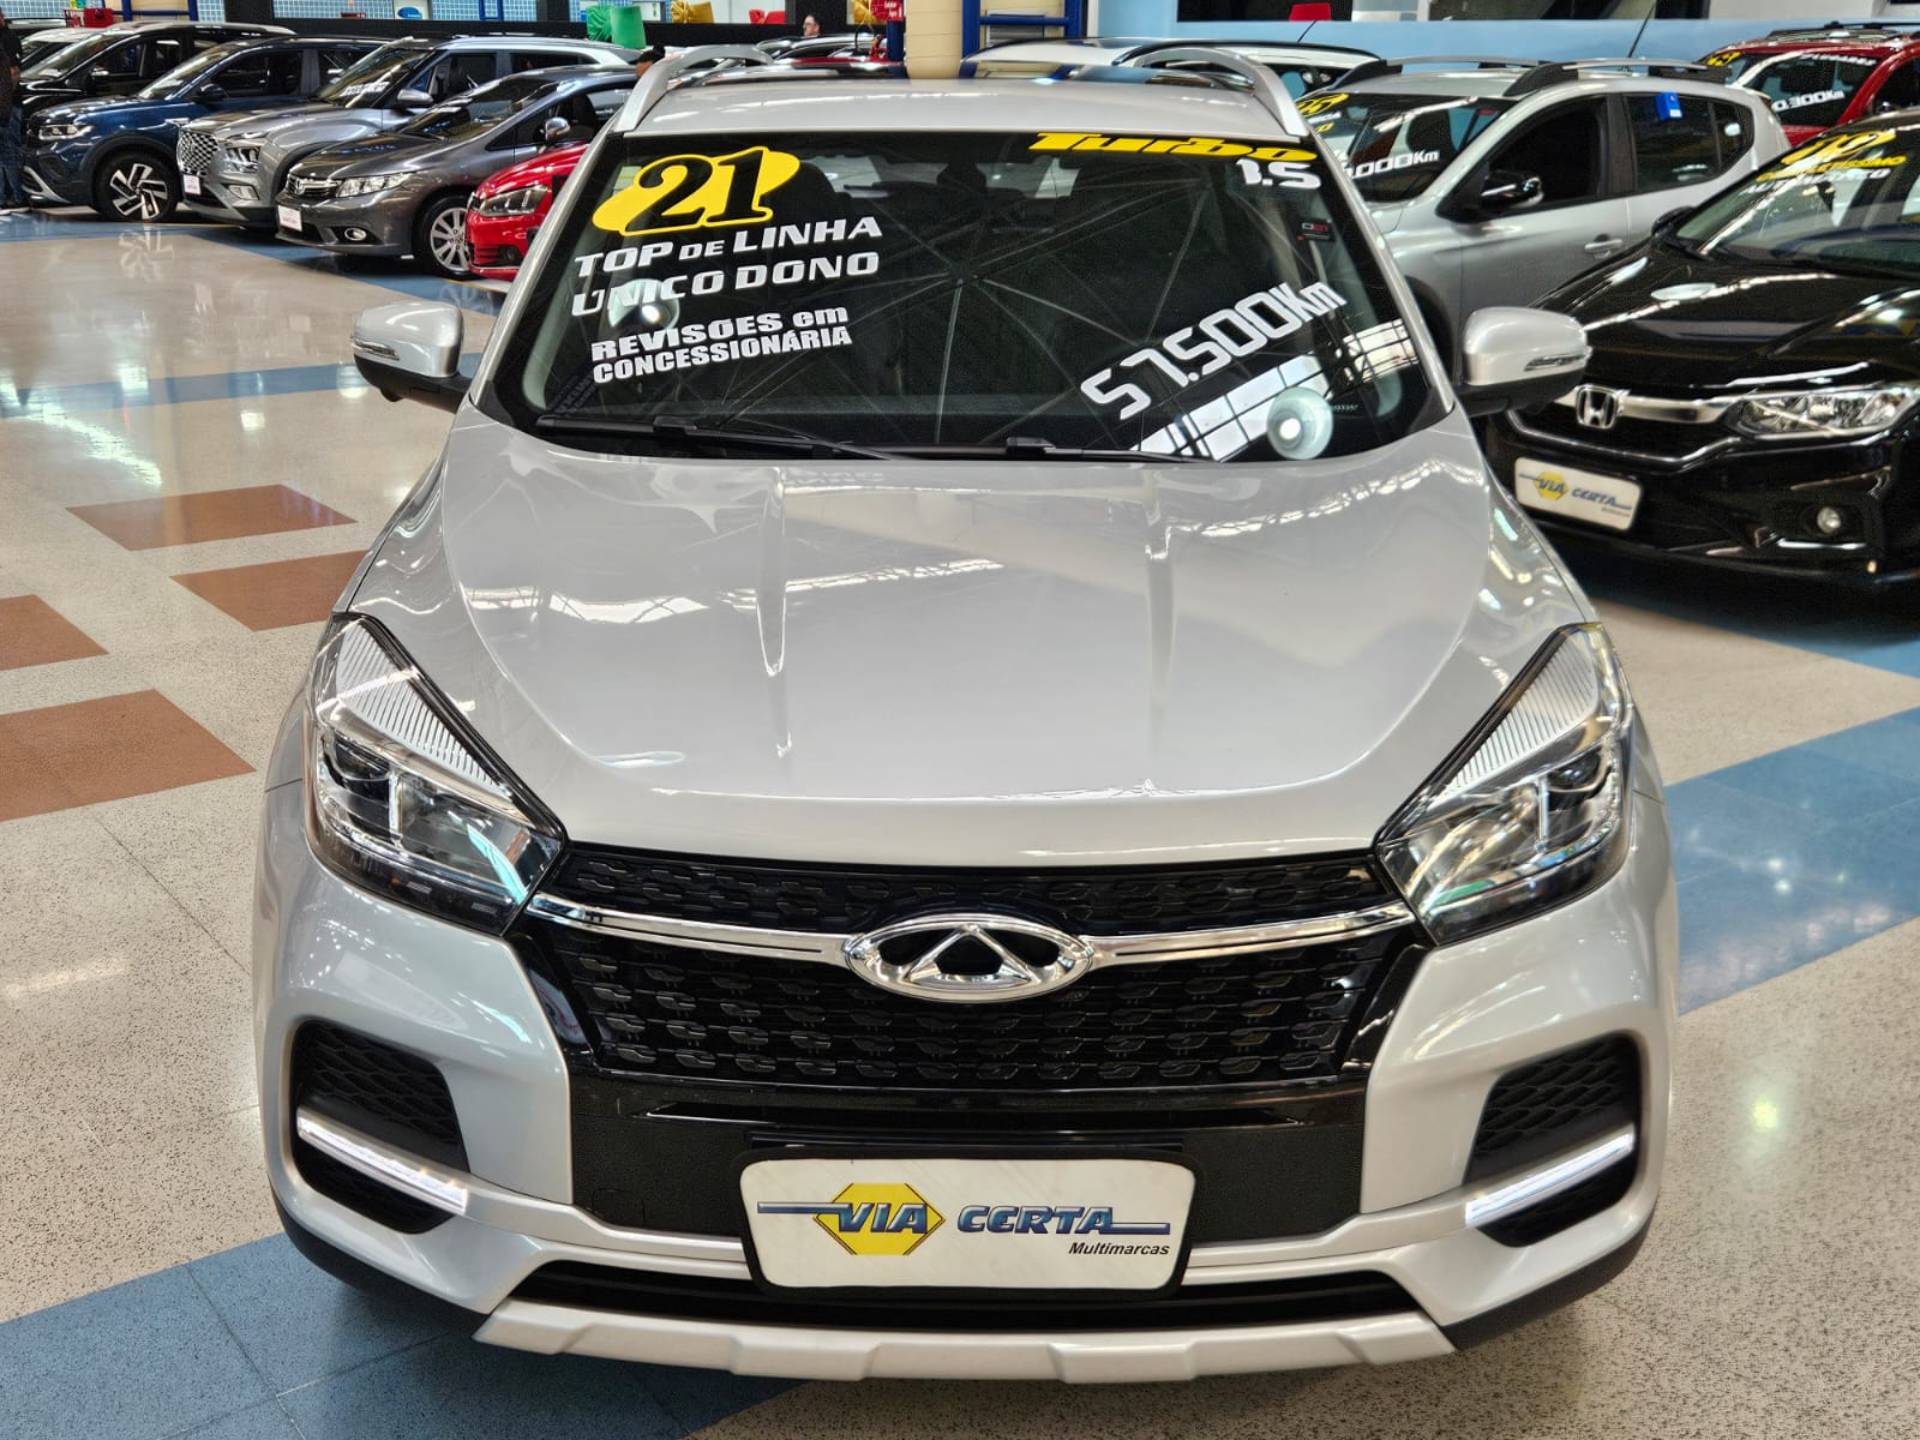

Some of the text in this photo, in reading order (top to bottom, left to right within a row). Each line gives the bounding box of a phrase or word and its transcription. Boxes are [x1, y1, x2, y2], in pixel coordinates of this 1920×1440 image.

[1028, 132, 1317, 162] Turbo
[622, 147, 770, 235] 21
[1236, 158, 1321, 190] 1.5
[574, 216, 883, 277] TOP DE LINHA
[735, 251, 880, 290] DONO
[593, 325, 853, 384] CONCESSIONÁRIA
[830, 1202, 1113, 1235] VIA CERTA
[1068, 1242, 1170, 1255] Multimarcas
